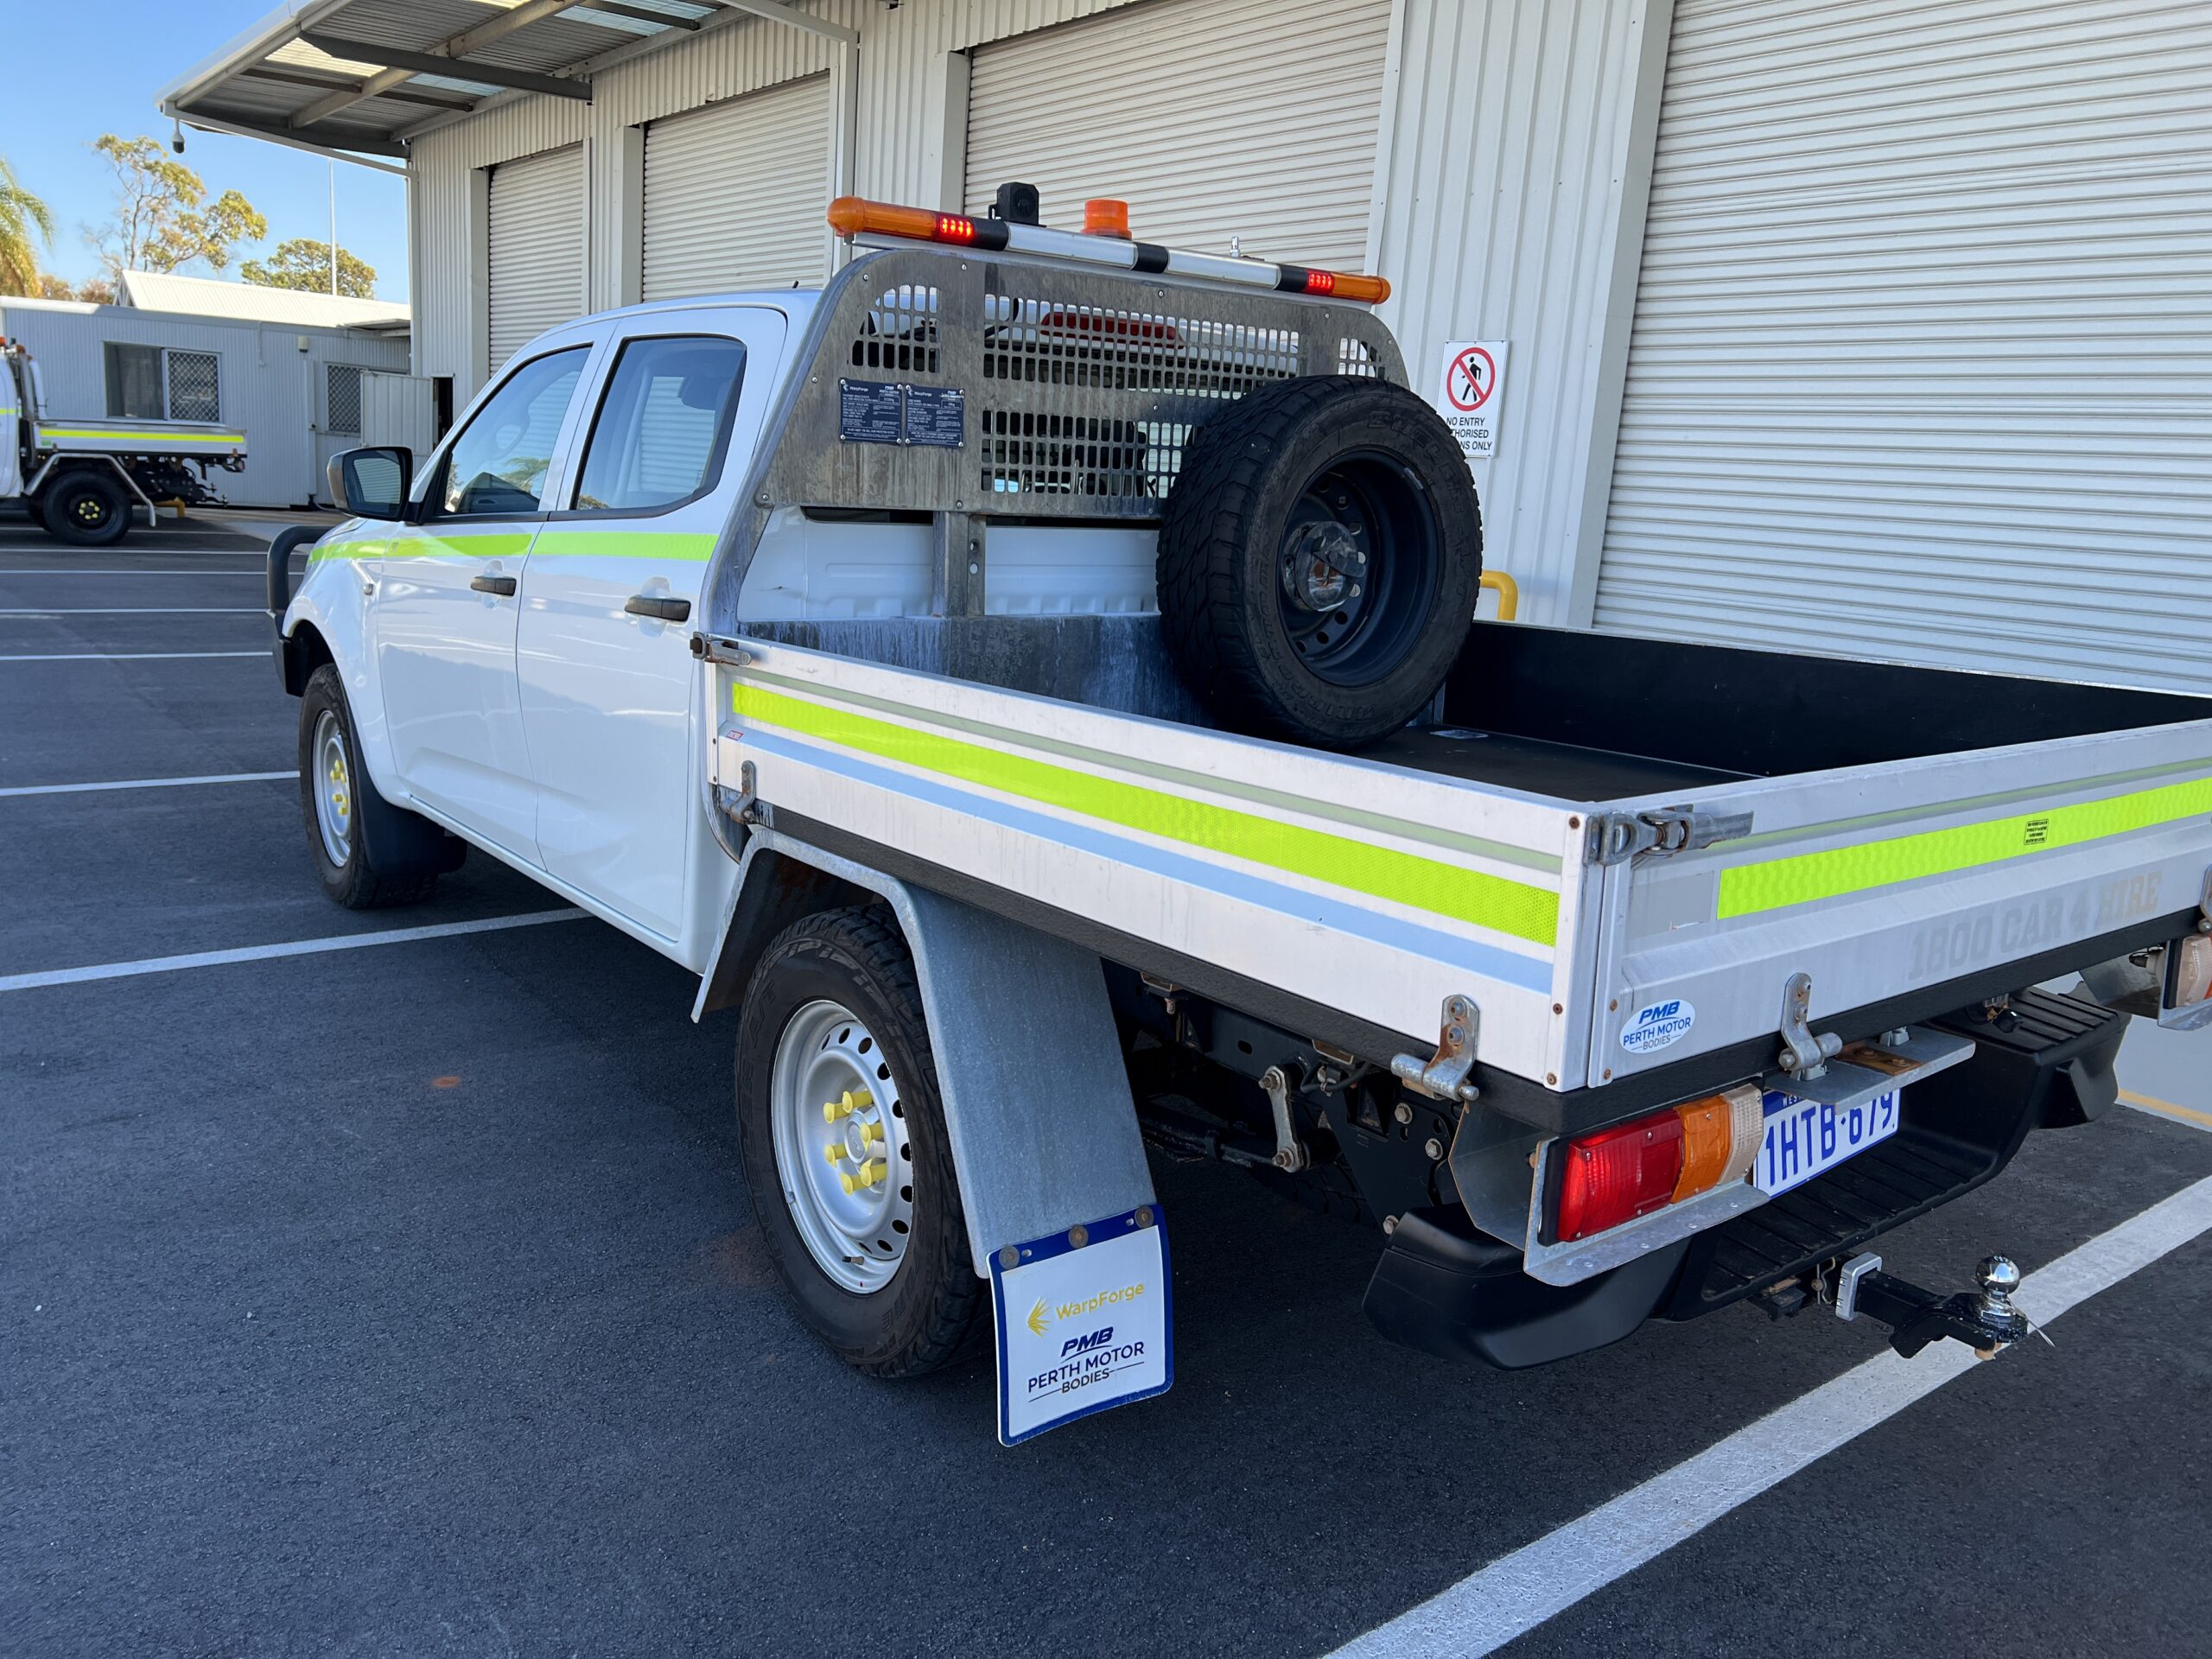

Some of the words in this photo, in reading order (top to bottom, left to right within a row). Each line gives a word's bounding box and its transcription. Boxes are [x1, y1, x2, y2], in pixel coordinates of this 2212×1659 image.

[1446, 417, 1458, 426] NO
[1459, 417, 1485, 426] ENTRY
[1472, 442, 1492, 450] ONLY
[1908, 915, 1993, 981] 1800
[2000, 898, 2064, 953] CAR
[2069, 890, 2088, 933] 4
[2094, 870, 2163, 930] HIRE
[1638, 1001, 1680, 1024] PMB
[1624, 1028, 1655, 1046] PERTH
[1657, 1017, 1691, 1036] MOTOR
[1643, 1035, 1670, 1050] BODIES
[1056, 1283, 1146, 1321] WarpForge
[1060, 1326, 1114, 1357] PMB
[1028, 1361, 1080, 1393] PERTH
[1085, 1341, 1145, 1370] MOTOR
[1061, 1368, 1110, 1394] BODIES
